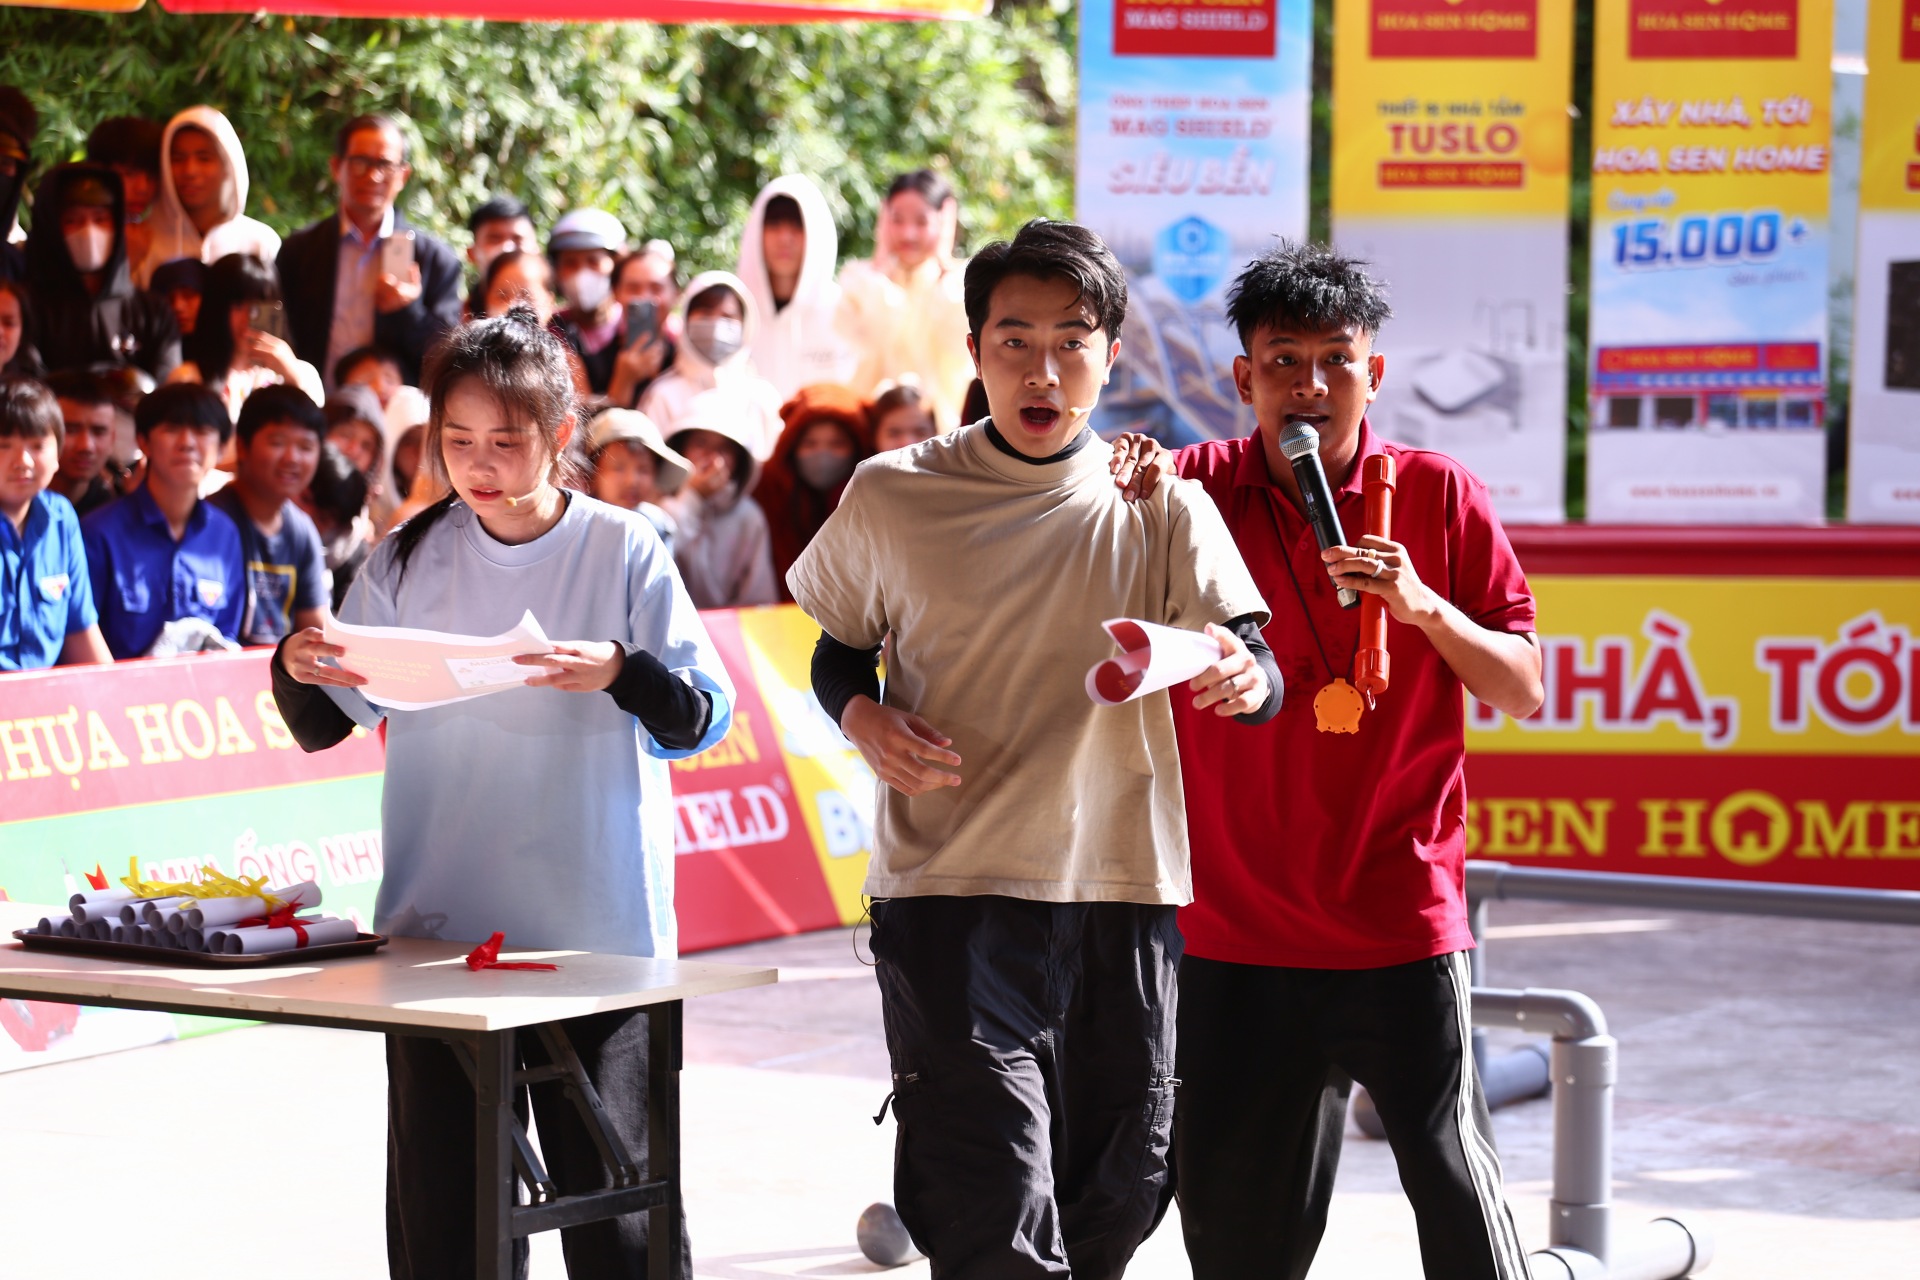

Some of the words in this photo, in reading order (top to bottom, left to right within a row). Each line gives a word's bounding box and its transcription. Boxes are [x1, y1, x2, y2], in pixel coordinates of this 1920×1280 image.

[1388, 122, 1519, 155] TUSLO
[1611, 94, 1674, 128] XÂY
[1592, 147, 1661, 173] HOA
[1667, 147, 1728, 173] SEN
[1733, 147, 1827, 173] HOME
[1468, 610, 1738, 746] HÀ,
[0, 704, 129, 790] HỰA
[125, 696, 257, 765] HOA
[672, 784, 789, 855] IELD
[1637, 790, 1920, 866] HOME
